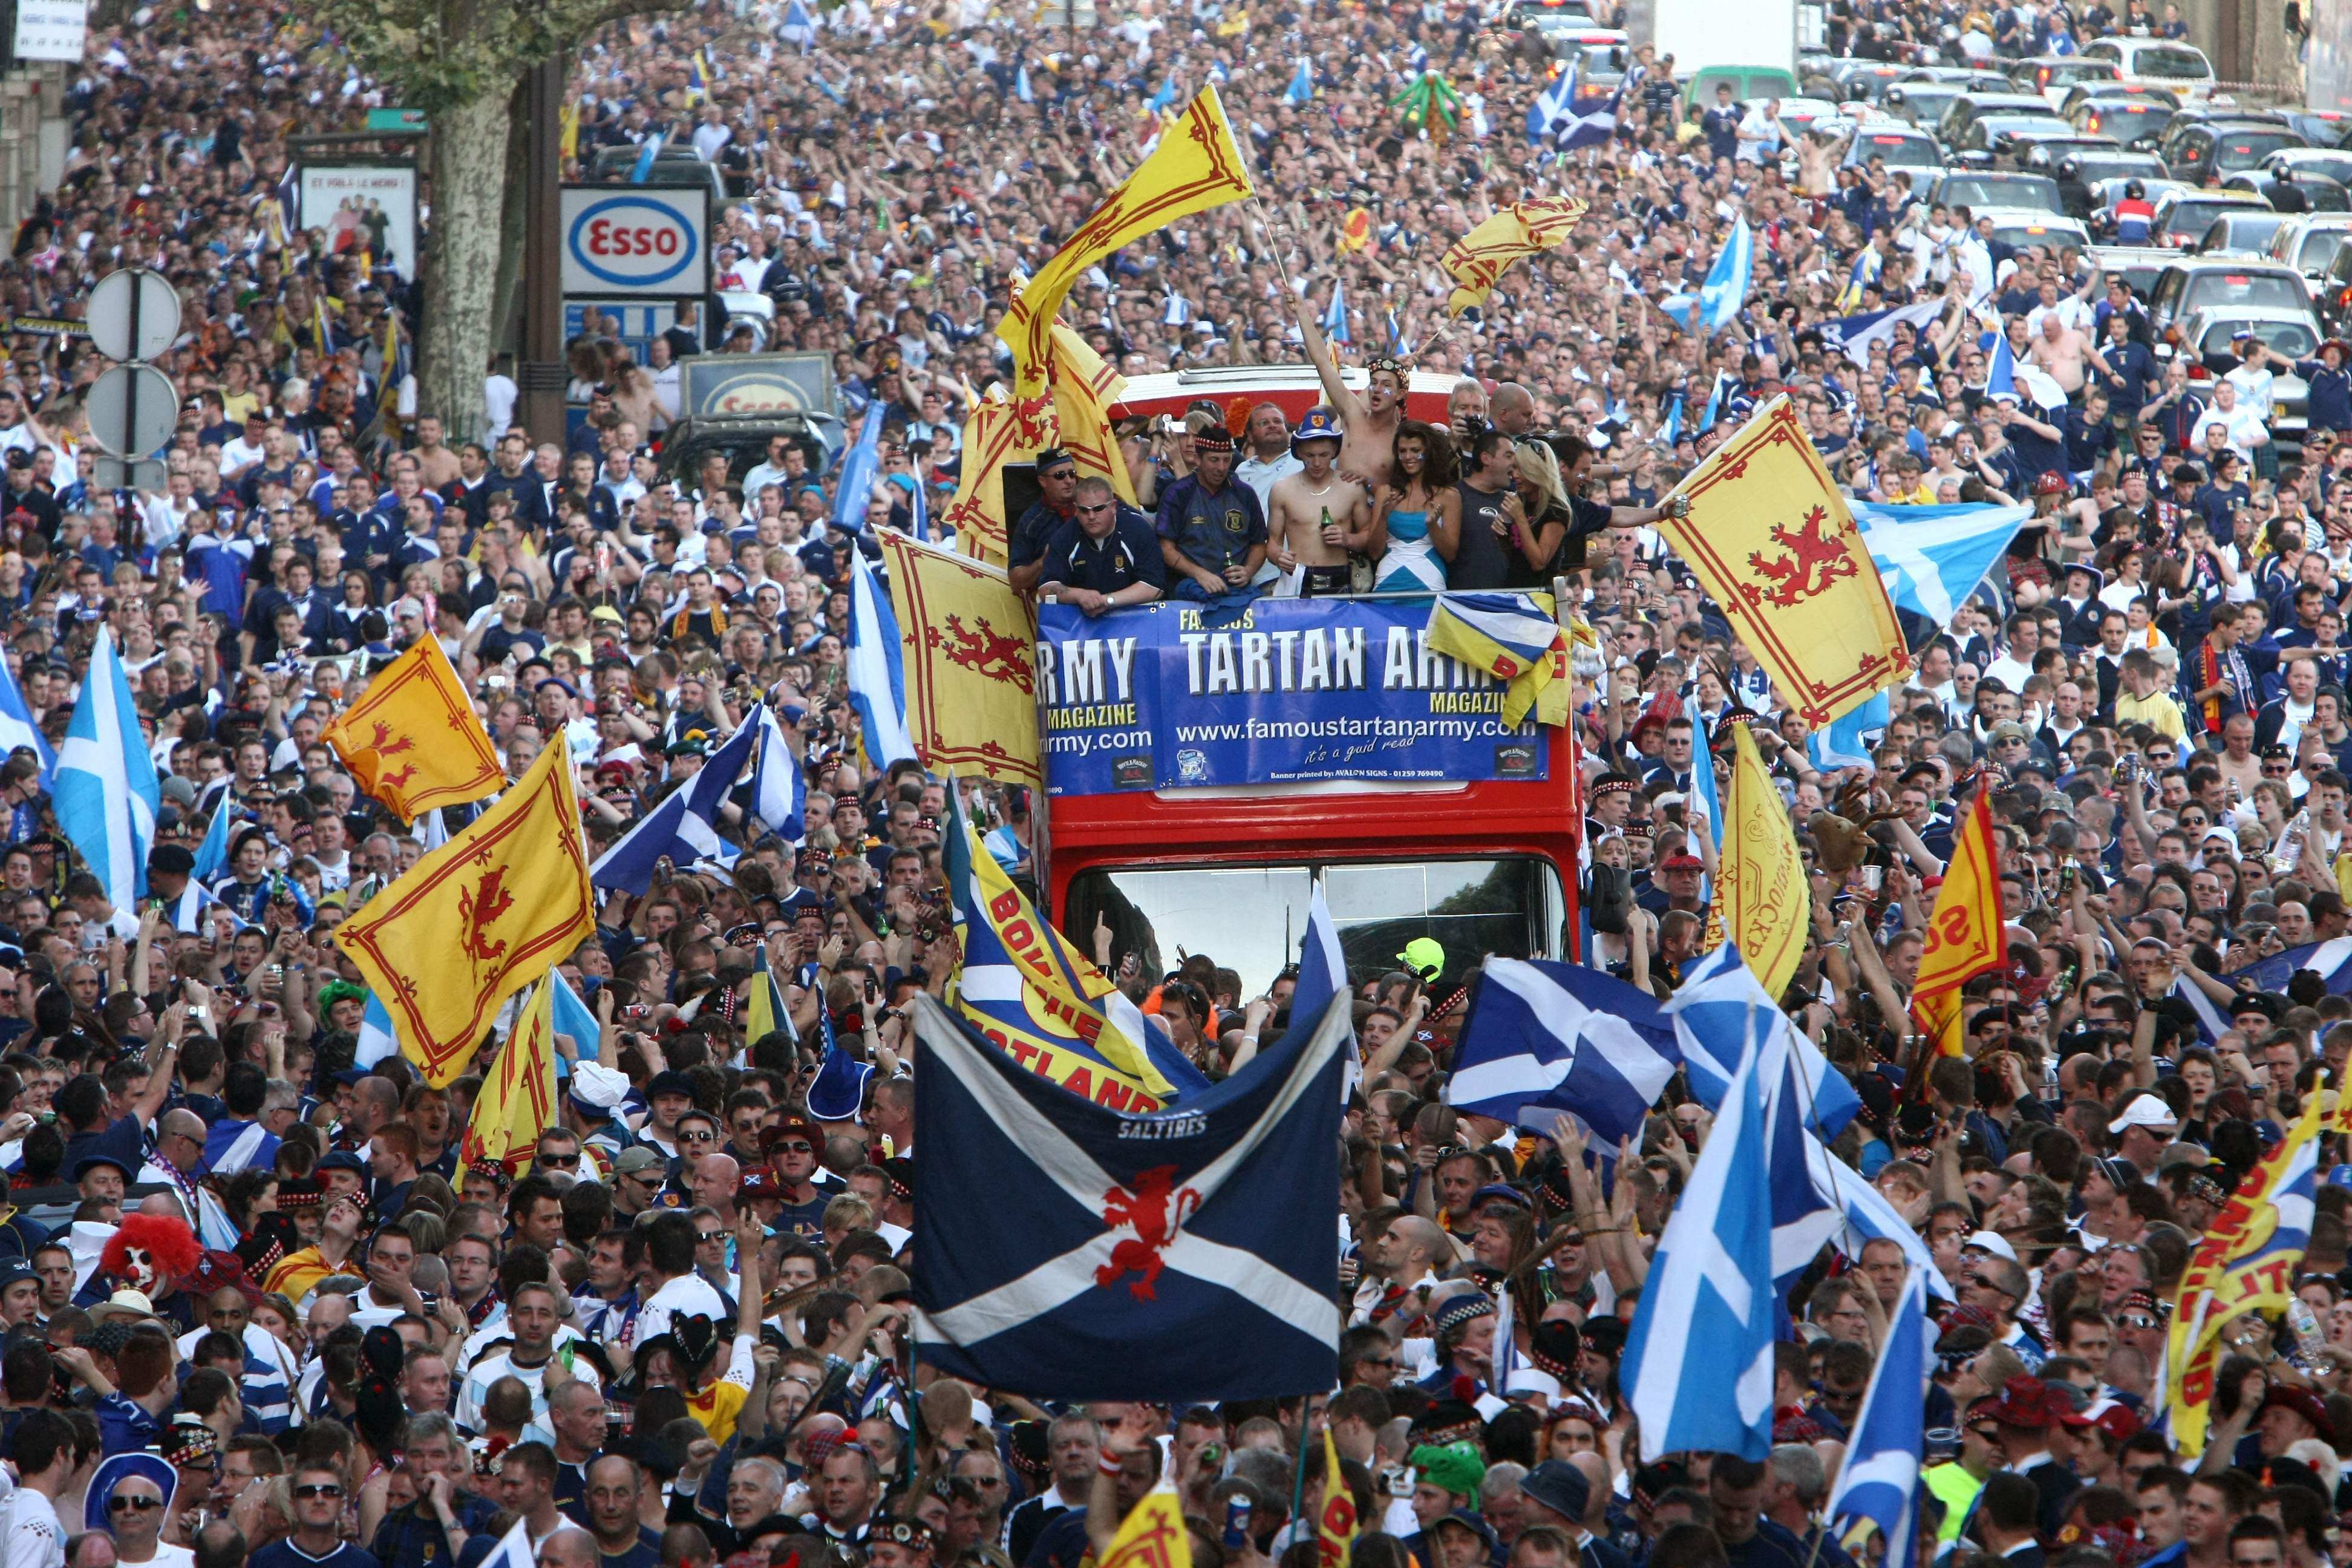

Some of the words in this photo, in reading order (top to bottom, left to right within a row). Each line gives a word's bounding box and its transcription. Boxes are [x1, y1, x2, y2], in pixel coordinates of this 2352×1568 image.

[589, 218, 678, 256] Esso
[1180, 627, 1365, 695] TARTAN
[1047, 703, 1137, 730] MAGAZINE
[1176, 716, 1537, 742] www.famoustartanarmy.com
[1304, 745, 1327, 765] it's
[1332, 750, 1341, 758] a
[1344, 737, 1377, 762] guid
[1381, 731, 1417, 751] read
[1117, 1115, 1208, 1139] SALTIRES
